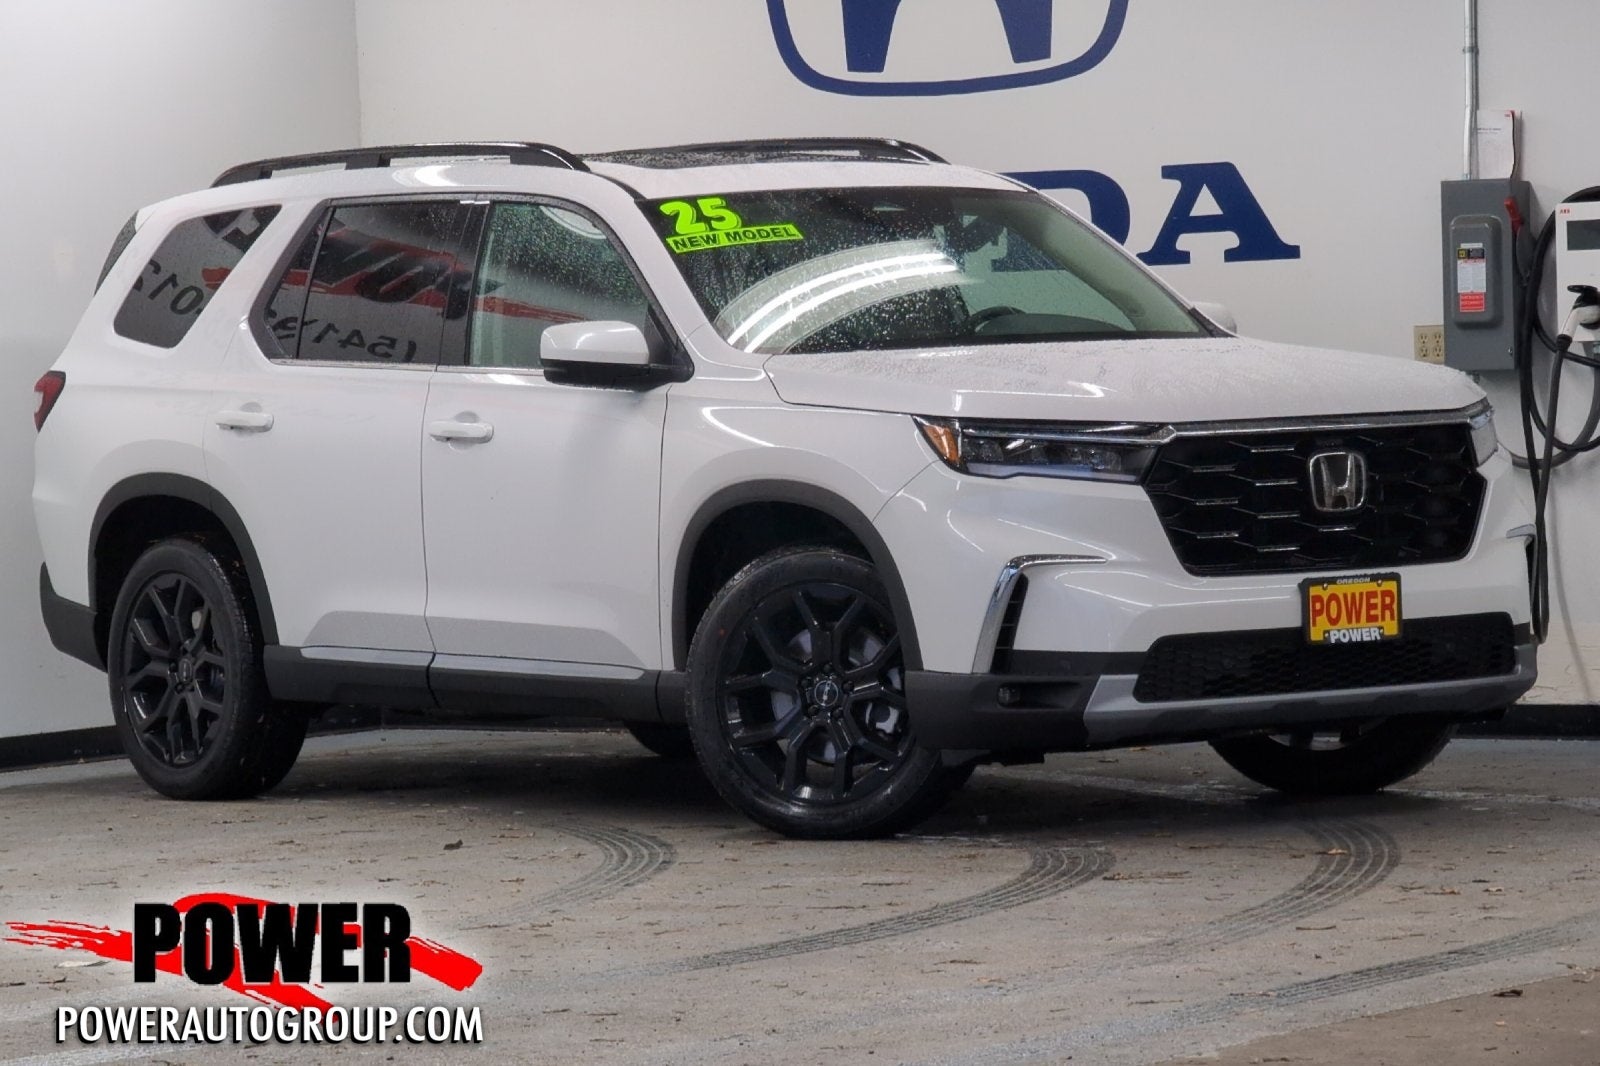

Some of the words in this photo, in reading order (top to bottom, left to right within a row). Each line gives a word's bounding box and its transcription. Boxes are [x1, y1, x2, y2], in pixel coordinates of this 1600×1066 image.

[659, 197, 742, 235] 25
[672, 234, 718, 251] NEW
[724, 226, 796, 243] MODEL
[1336, 577, 1371, 585] OREGON
[1310, 589, 1396, 628] POWER
[1329, 627, 1381, 644] POWER
